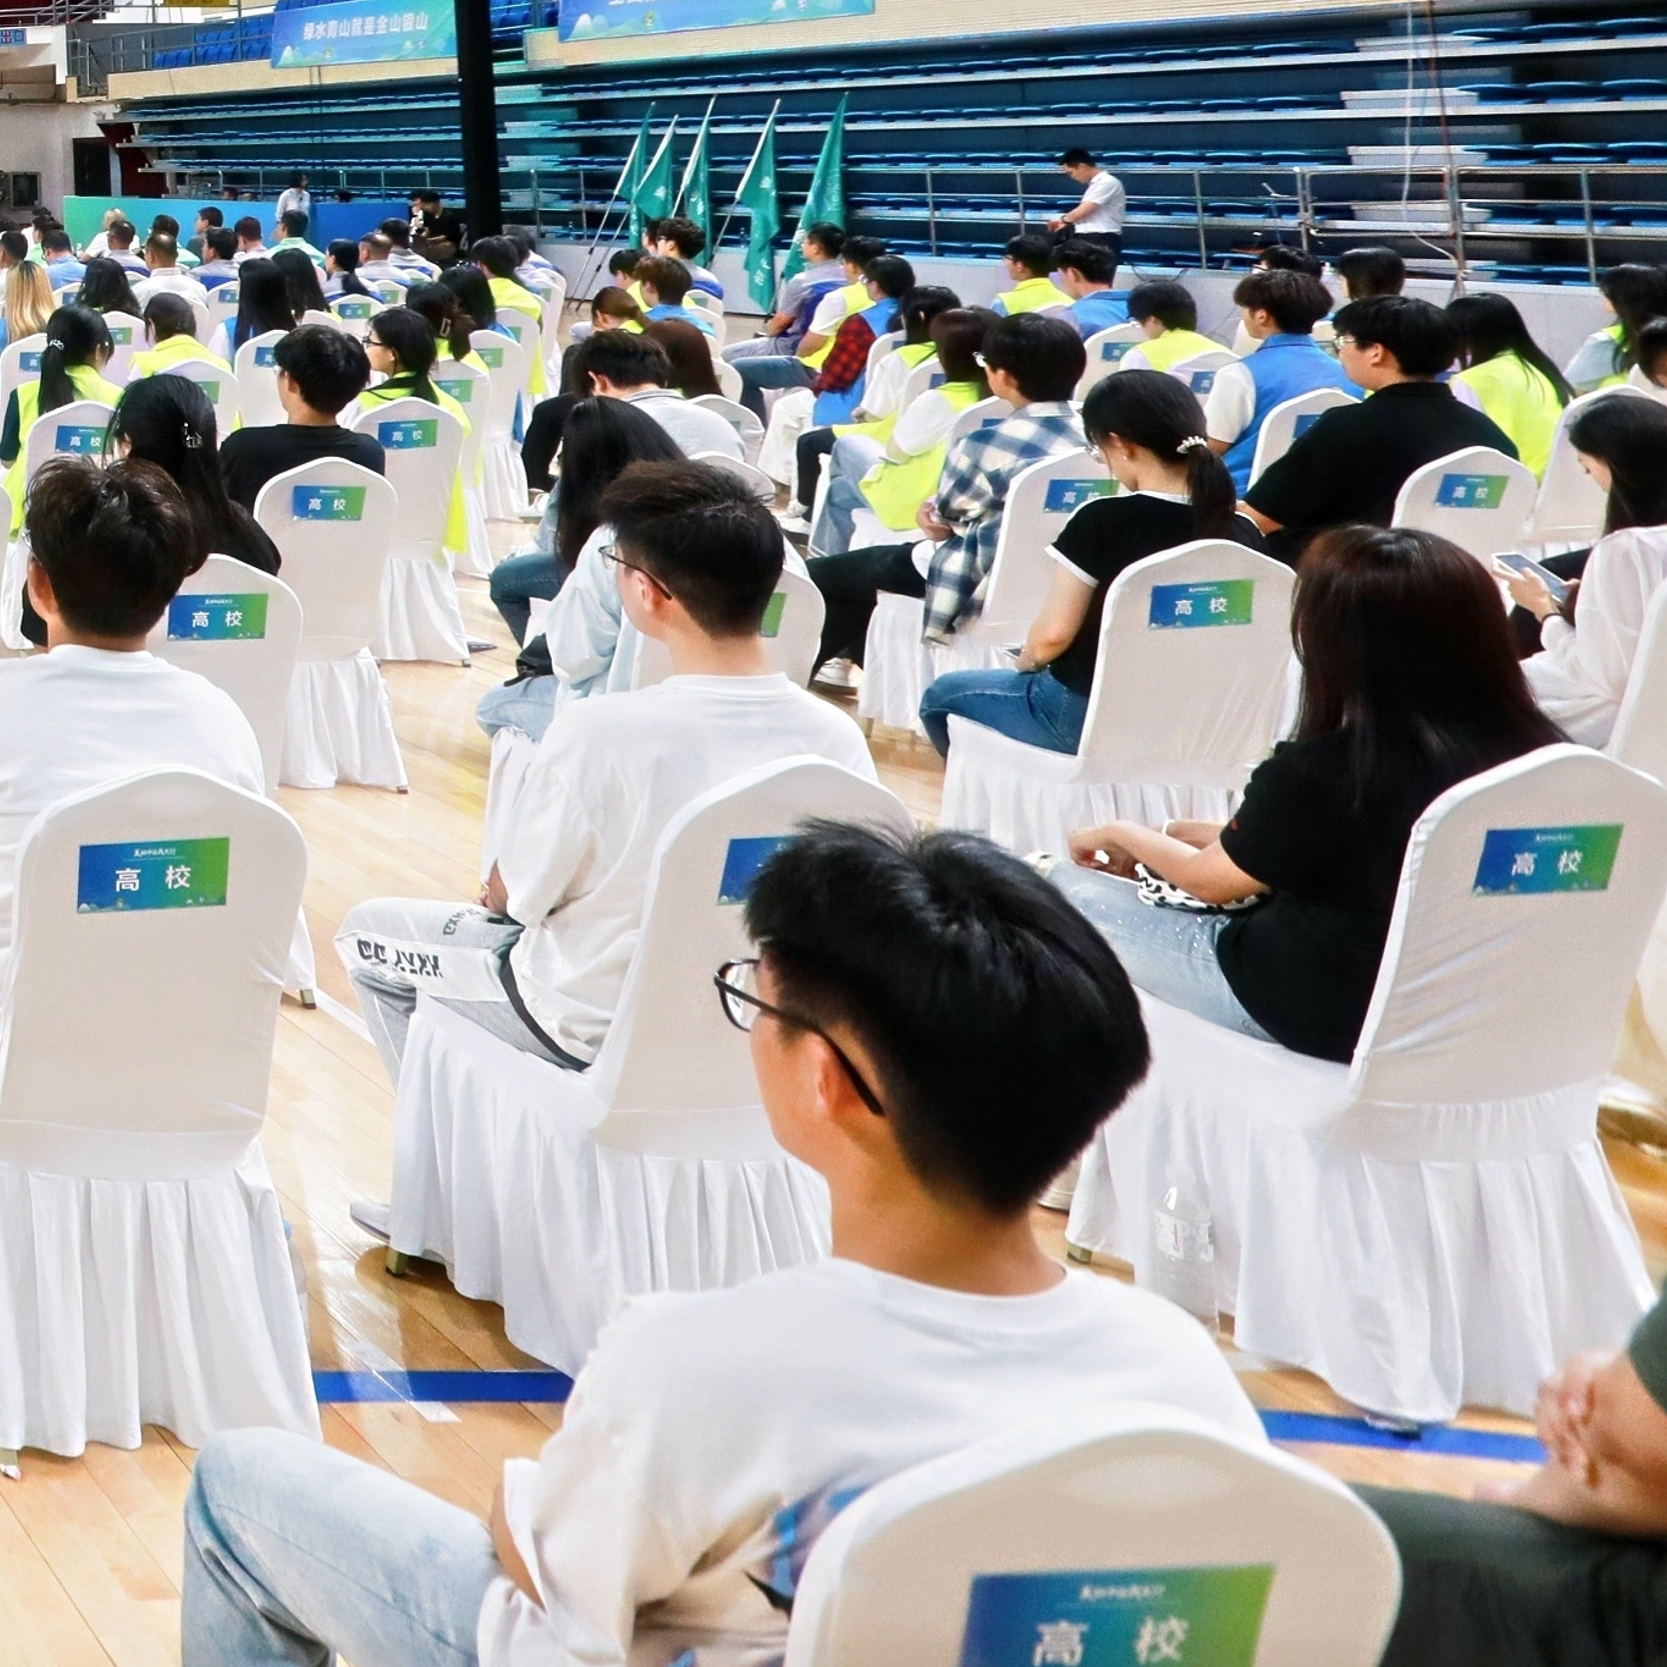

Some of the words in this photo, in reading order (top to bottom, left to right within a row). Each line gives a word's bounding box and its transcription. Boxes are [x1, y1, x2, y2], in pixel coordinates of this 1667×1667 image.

[303, 12, 428, 41] 绿水青山就是金山银山
[70, 436, 101, 447] 高校
[392, 429, 423, 442] 高校
[1453, 486, 1488, 500] 高校
[308, 498, 346, 511] 高校
[1175, 596, 1228, 616] 高校
[192, 610, 243, 629] 高校
[1512, 850, 1582, 877] 高校
[116, 865, 192, 892] 高校
[1033, 1614, 1191, 1667] 高校
